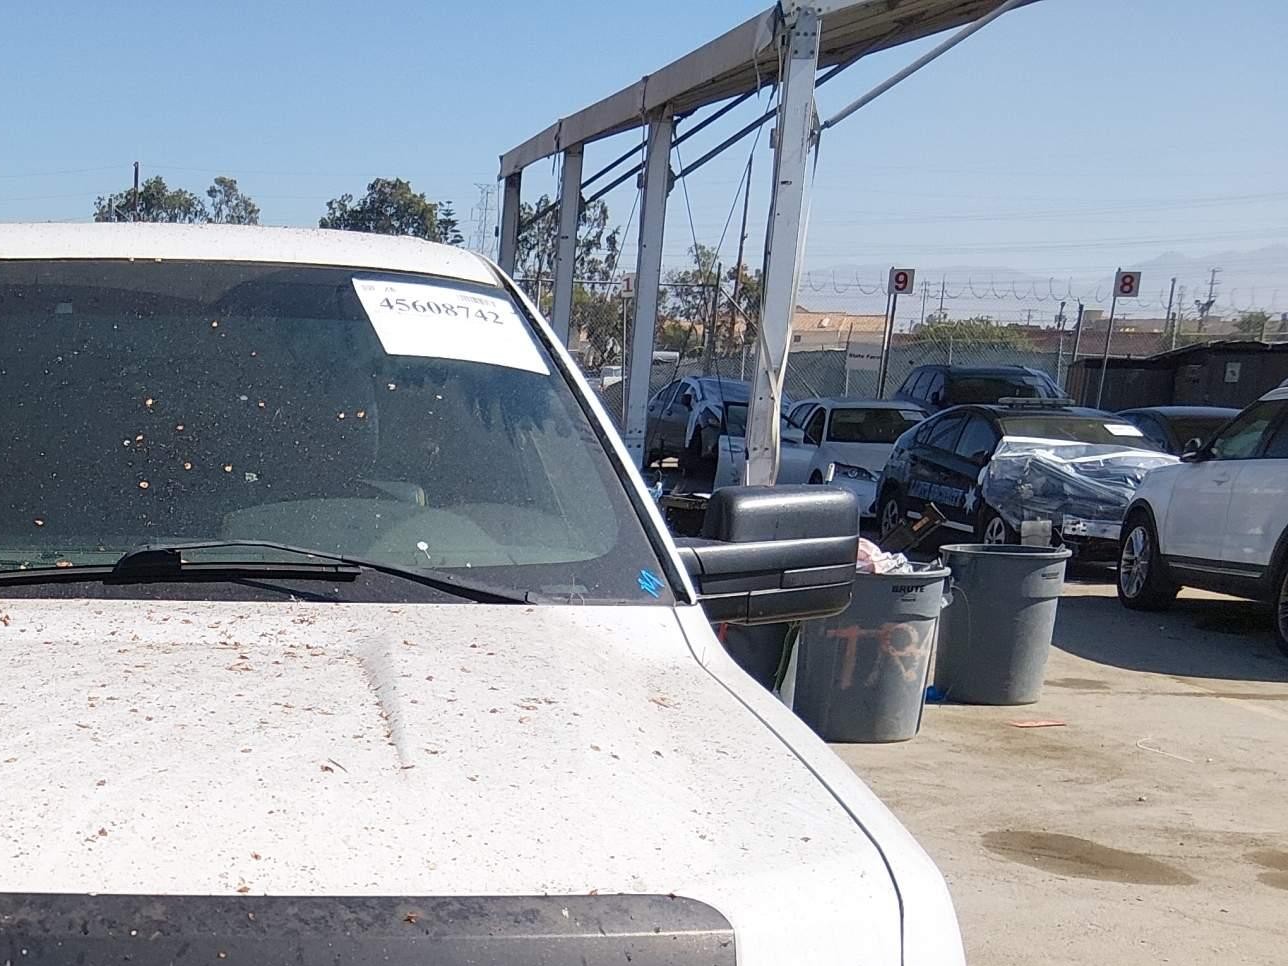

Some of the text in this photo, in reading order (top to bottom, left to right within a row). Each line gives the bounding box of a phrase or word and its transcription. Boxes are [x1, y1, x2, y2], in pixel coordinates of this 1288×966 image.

[894, 271, 909, 291] 9
[1119, 274, 1135, 294] 8
[379, 296, 504, 325] 45608742
[891, 584, 926, 593] BRUTE
